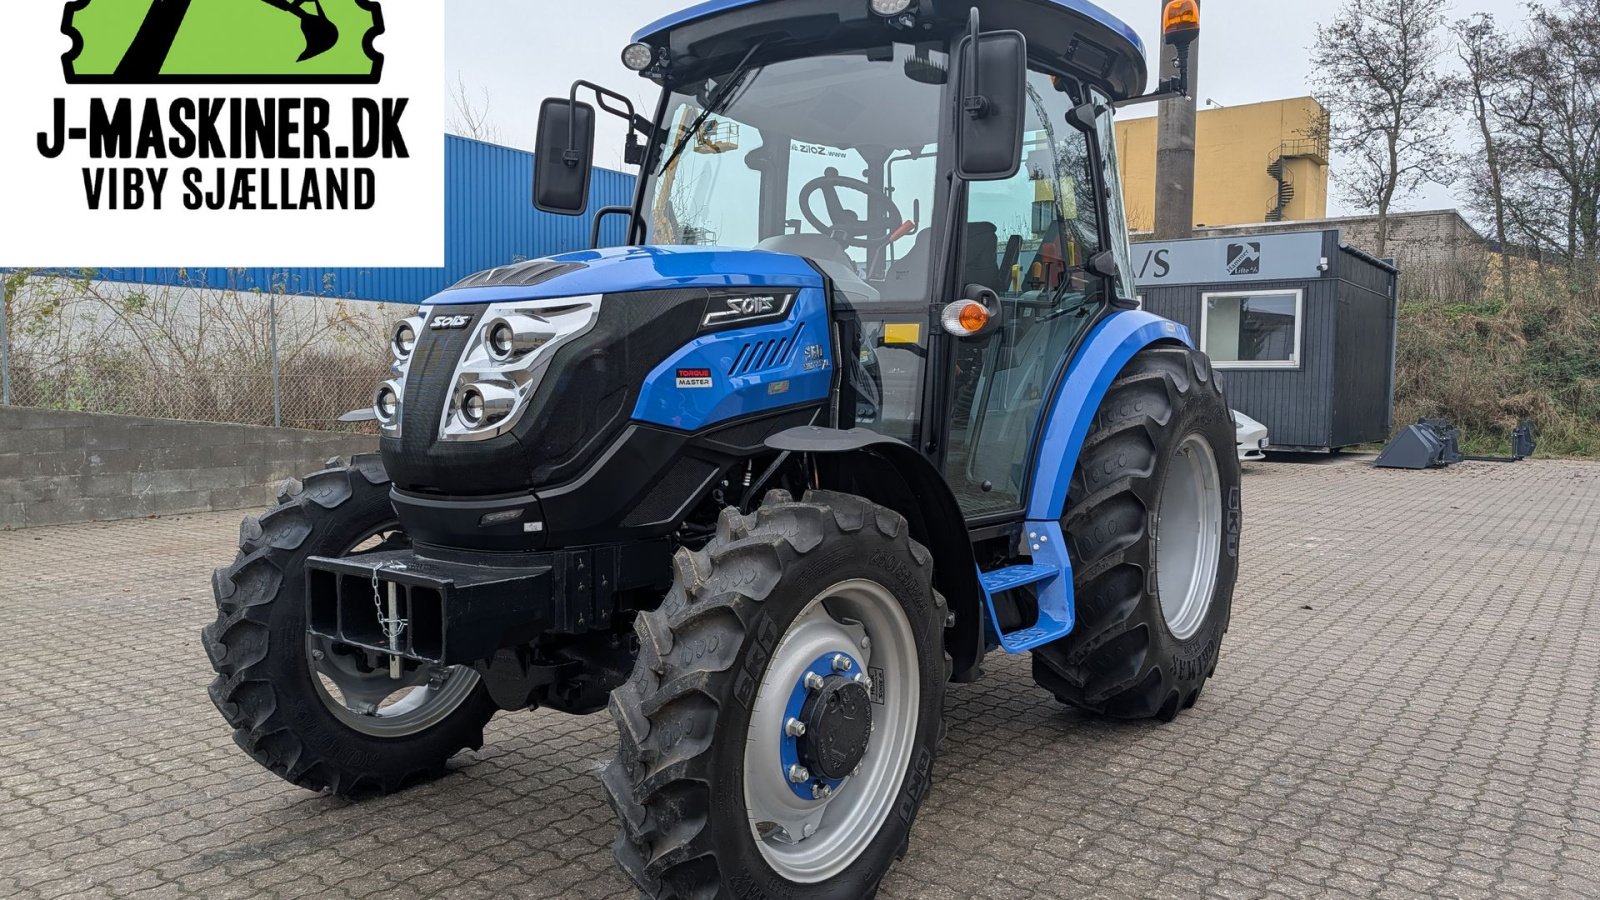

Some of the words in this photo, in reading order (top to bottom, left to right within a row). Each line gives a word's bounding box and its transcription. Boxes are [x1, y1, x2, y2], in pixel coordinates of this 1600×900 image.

[1133, 249, 1170, 278] /S
[1226, 249, 1249, 273] Hammer
[1226, 486, 1240, 557] BKT
[734, 611, 778, 710] BKT
[899, 744, 931, 826] BKT
